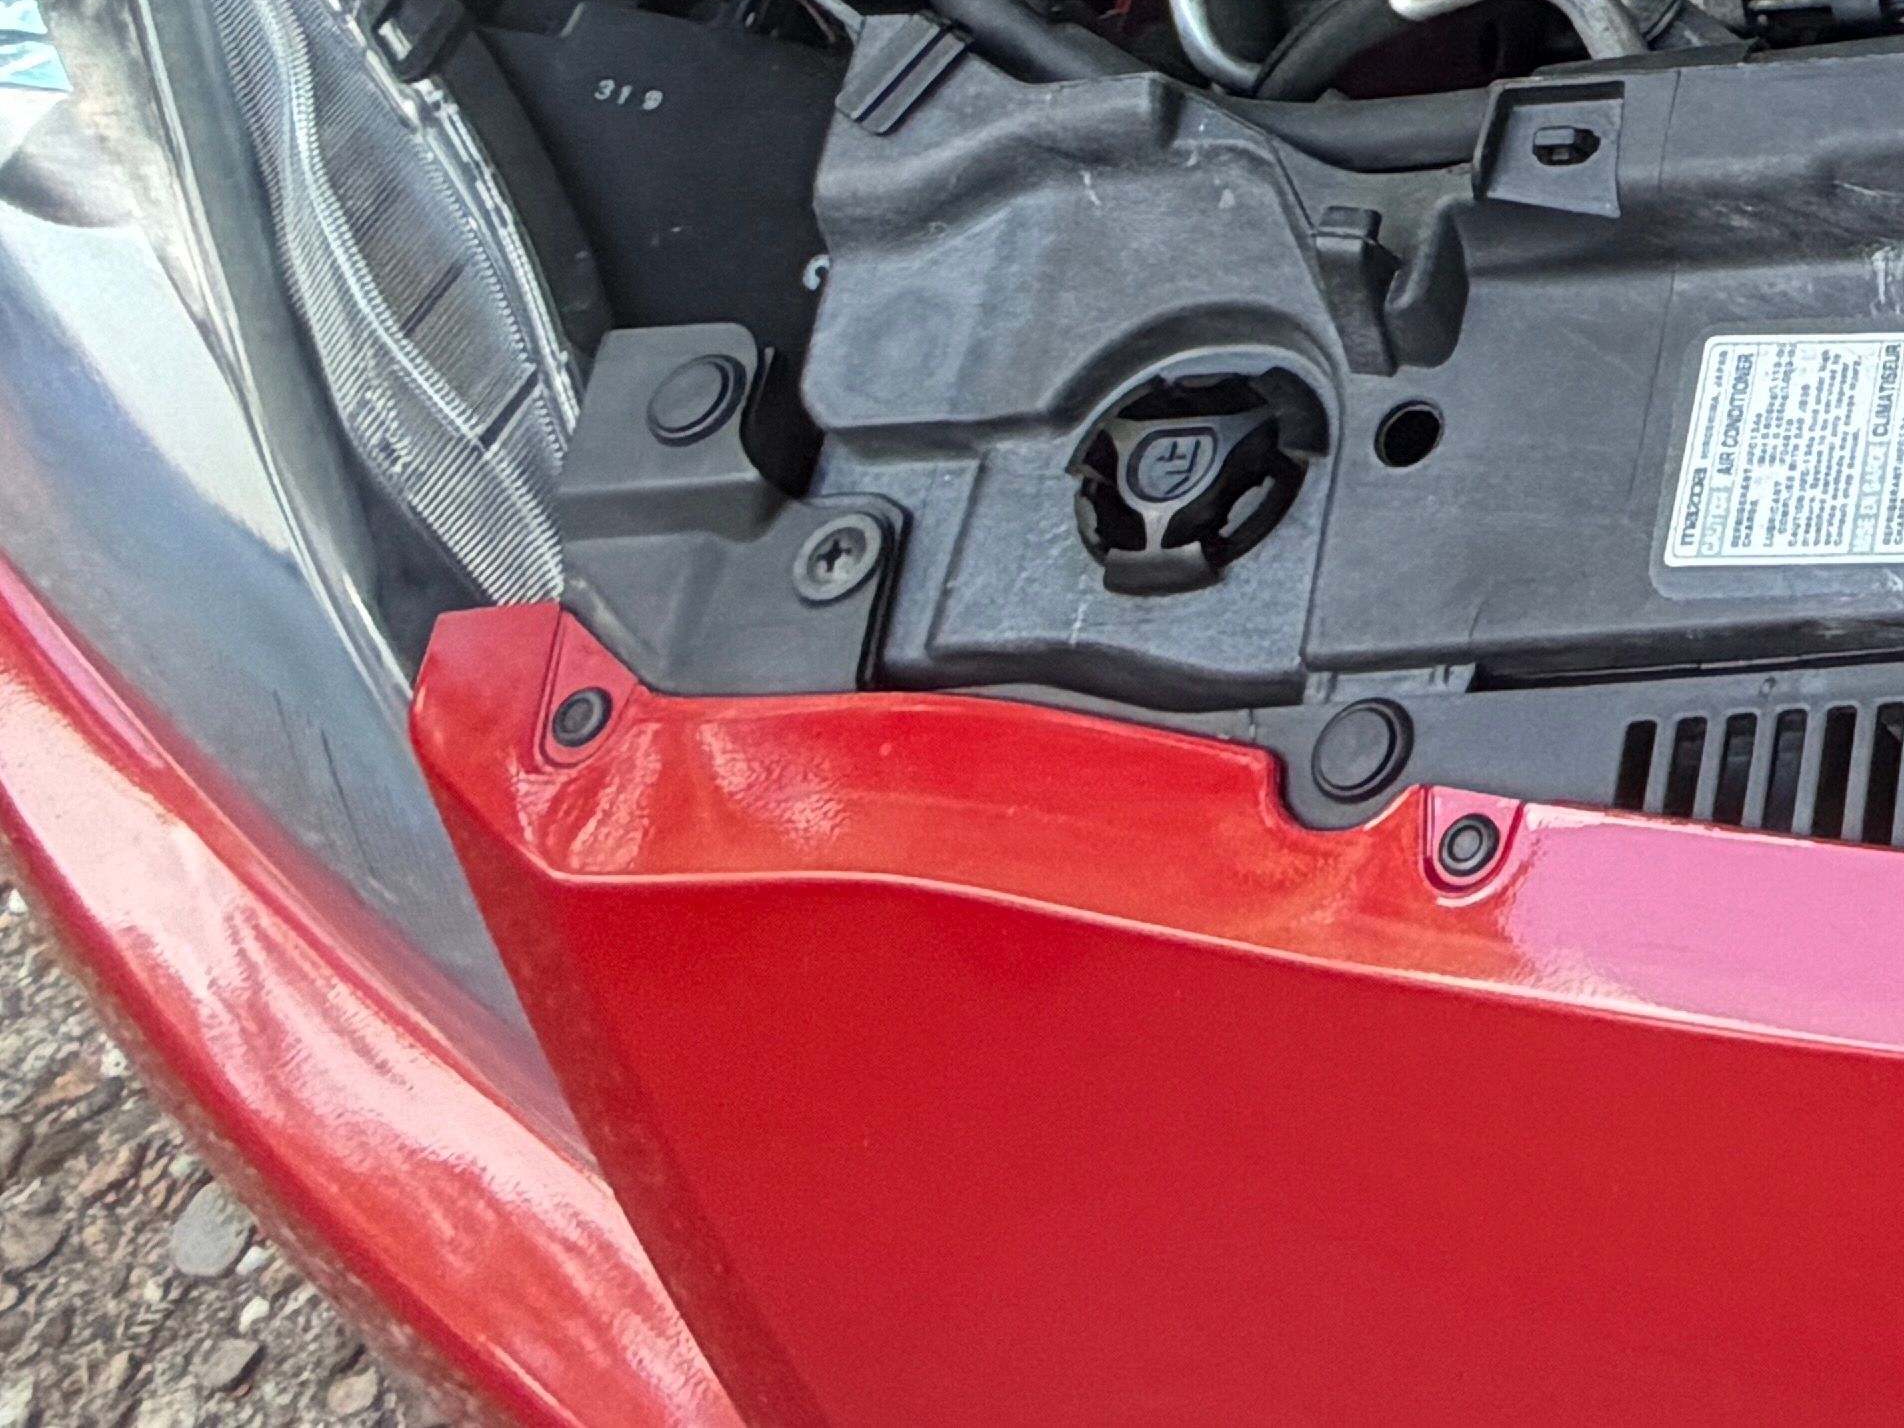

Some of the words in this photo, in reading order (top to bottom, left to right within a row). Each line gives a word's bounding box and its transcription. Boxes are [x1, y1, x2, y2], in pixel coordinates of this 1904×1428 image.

[1720, 353, 1754, 447] CONDITIONER
[1871, 343, 1902, 436] CLIMATISEUR
[1679, 467, 1707, 545] mazda
[1715, 452, 1736, 475] AIR
